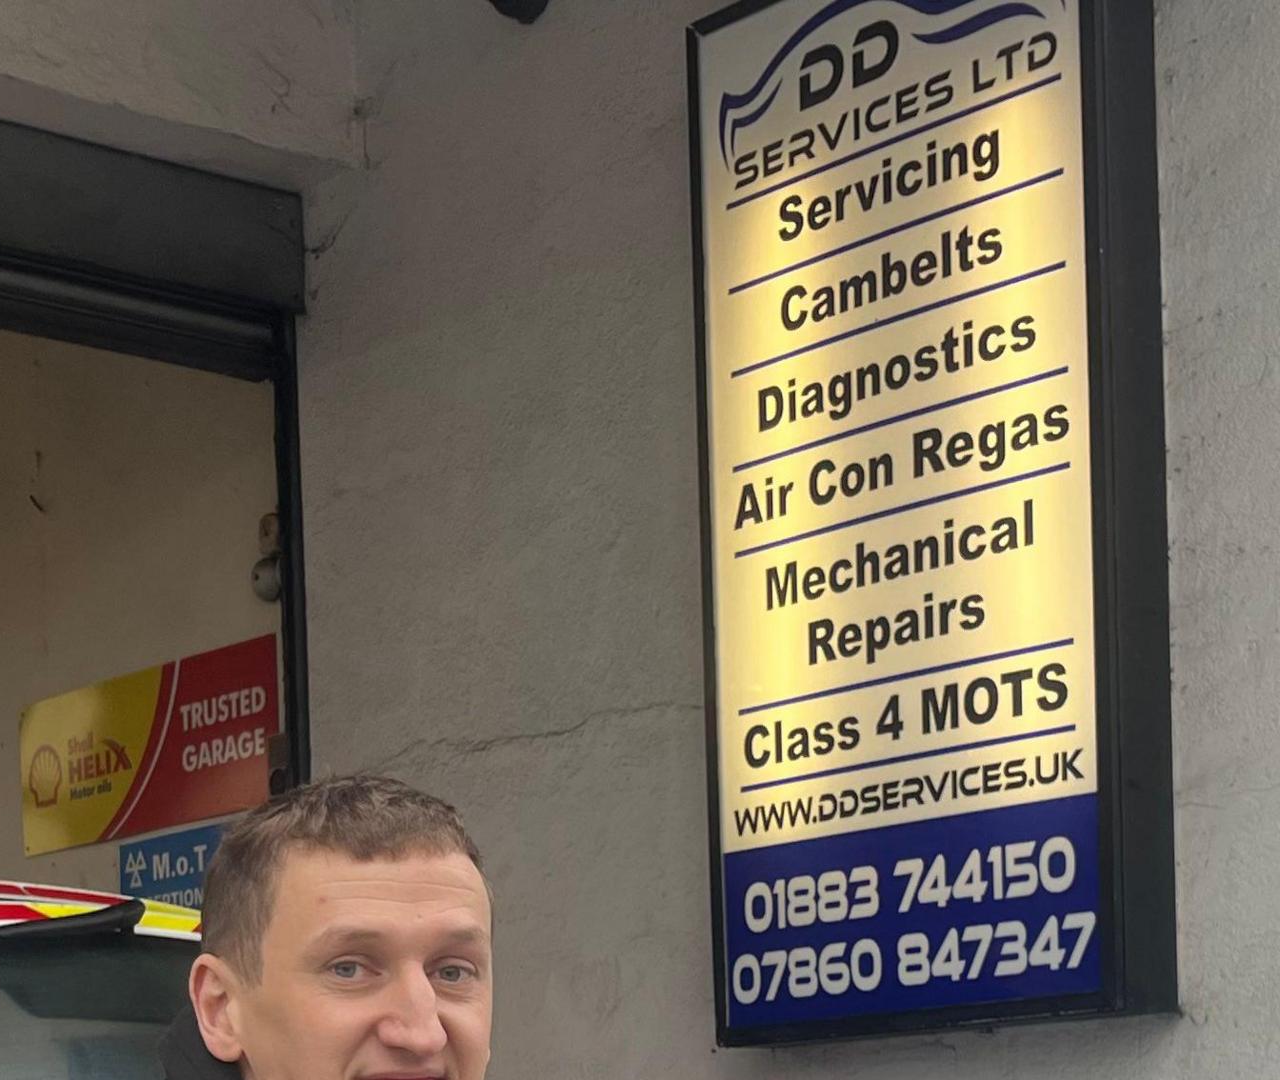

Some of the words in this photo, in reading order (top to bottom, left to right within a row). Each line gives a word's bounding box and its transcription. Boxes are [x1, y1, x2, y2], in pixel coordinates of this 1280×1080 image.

[734, 70, 953, 190] SERVICES
[971, 31, 1058, 93] LTD
[798, 20, 899, 111] DD
[778, 129, 1000, 242] Servicing
[780, 225, 1002, 331] Cambelts
[757, 315, 1036, 432] Diagnostics
[734, 478, 793, 530] Air
[809, 453, 893, 505] Con
[912, 404, 1069, 479] Regas
[766, 500, 1034, 611] Mechanical
[808, 593, 985, 665] Repairs
[68, 731, 93, 755] Shell
[180, 686, 266, 732] TRUSTED
[182, 727, 265, 772] GARAGE
[744, 715, 860, 770] Class
[876, 695, 904, 740] 4
[922, 662, 1069, 735] MOTS
[68, 737, 132, 784] HELIX
[734, 748, 1084, 836] WWW.DDSERVICES.UK
[744, 865, 879, 933] 01883
[892, 836, 1075, 913] 744150
[732, 938, 882, 1005] 07860
[897, 912, 1096, 987] 847347
